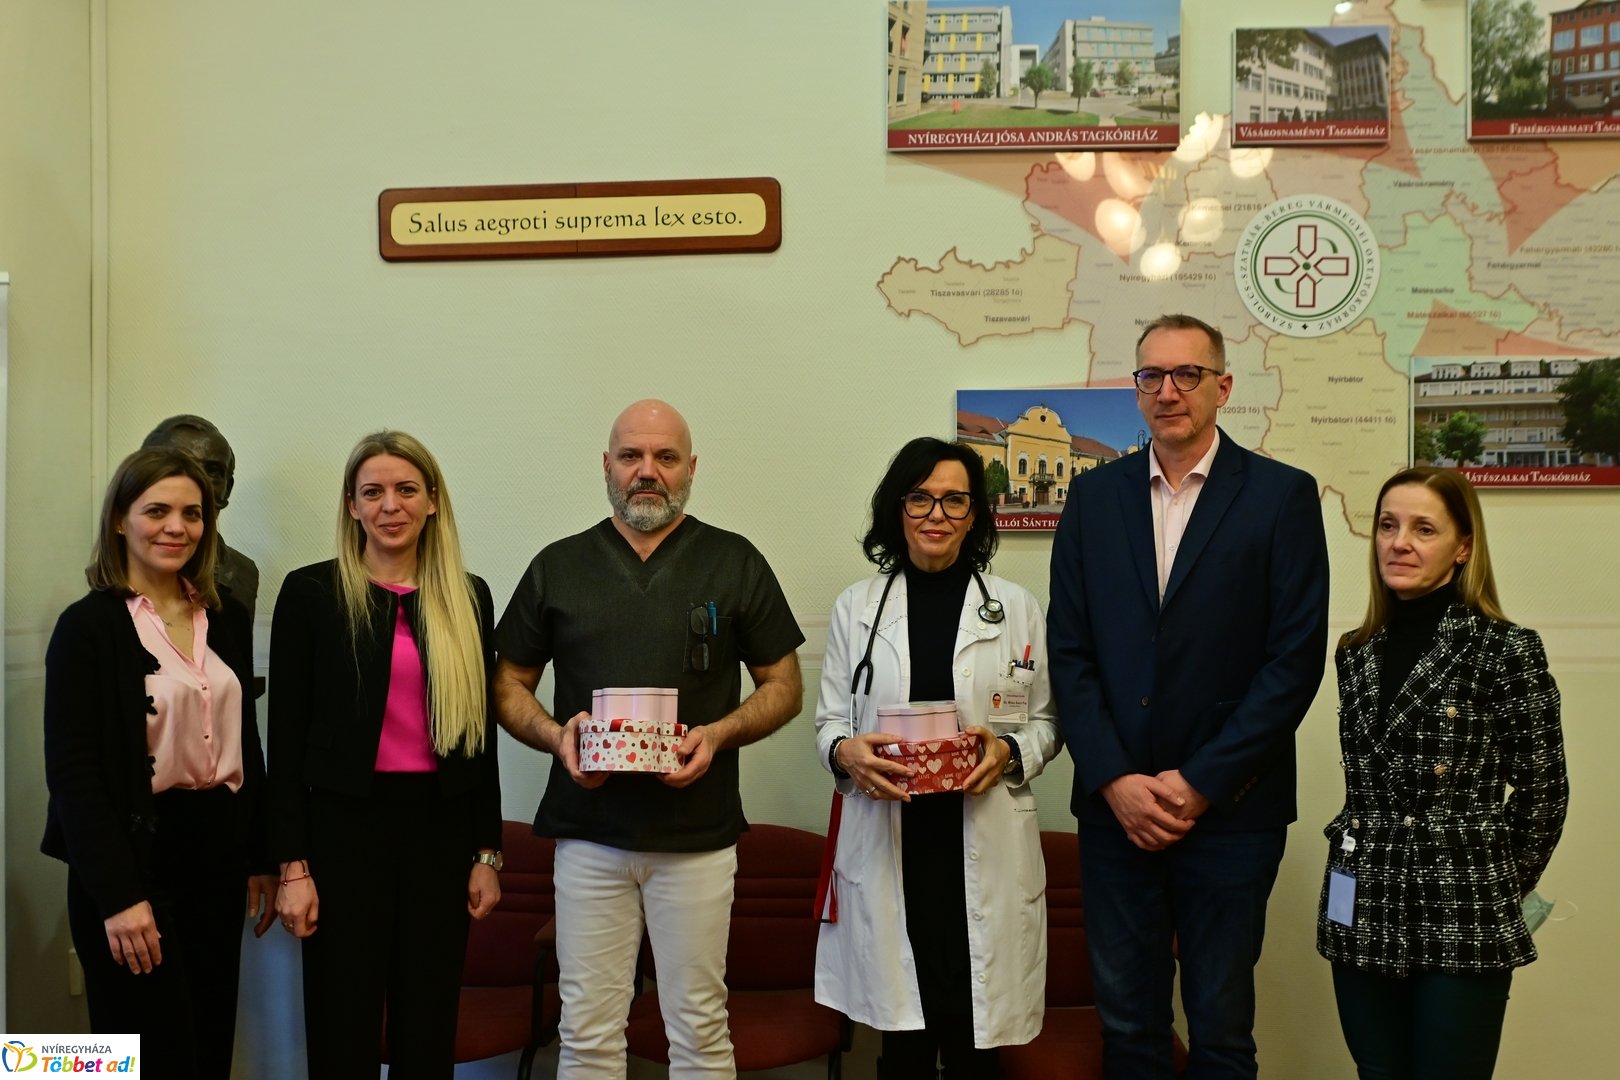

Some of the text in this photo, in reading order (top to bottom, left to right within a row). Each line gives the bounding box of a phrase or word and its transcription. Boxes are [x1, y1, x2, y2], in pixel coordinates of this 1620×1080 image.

[908, 128, 1159, 146] NYÍREGYHÁZI JÓSA ANDRÁS TAGKÓRHÁZ
[1240, 124, 1386, 138] VÁSÁROSNAMÉNYI TAGKÓRHÁZ
[409, 206, 743, 236] Salus aegroti suprema lex esto.
[1530, 470, 1591, 482] TAGKÓRHÁZ
